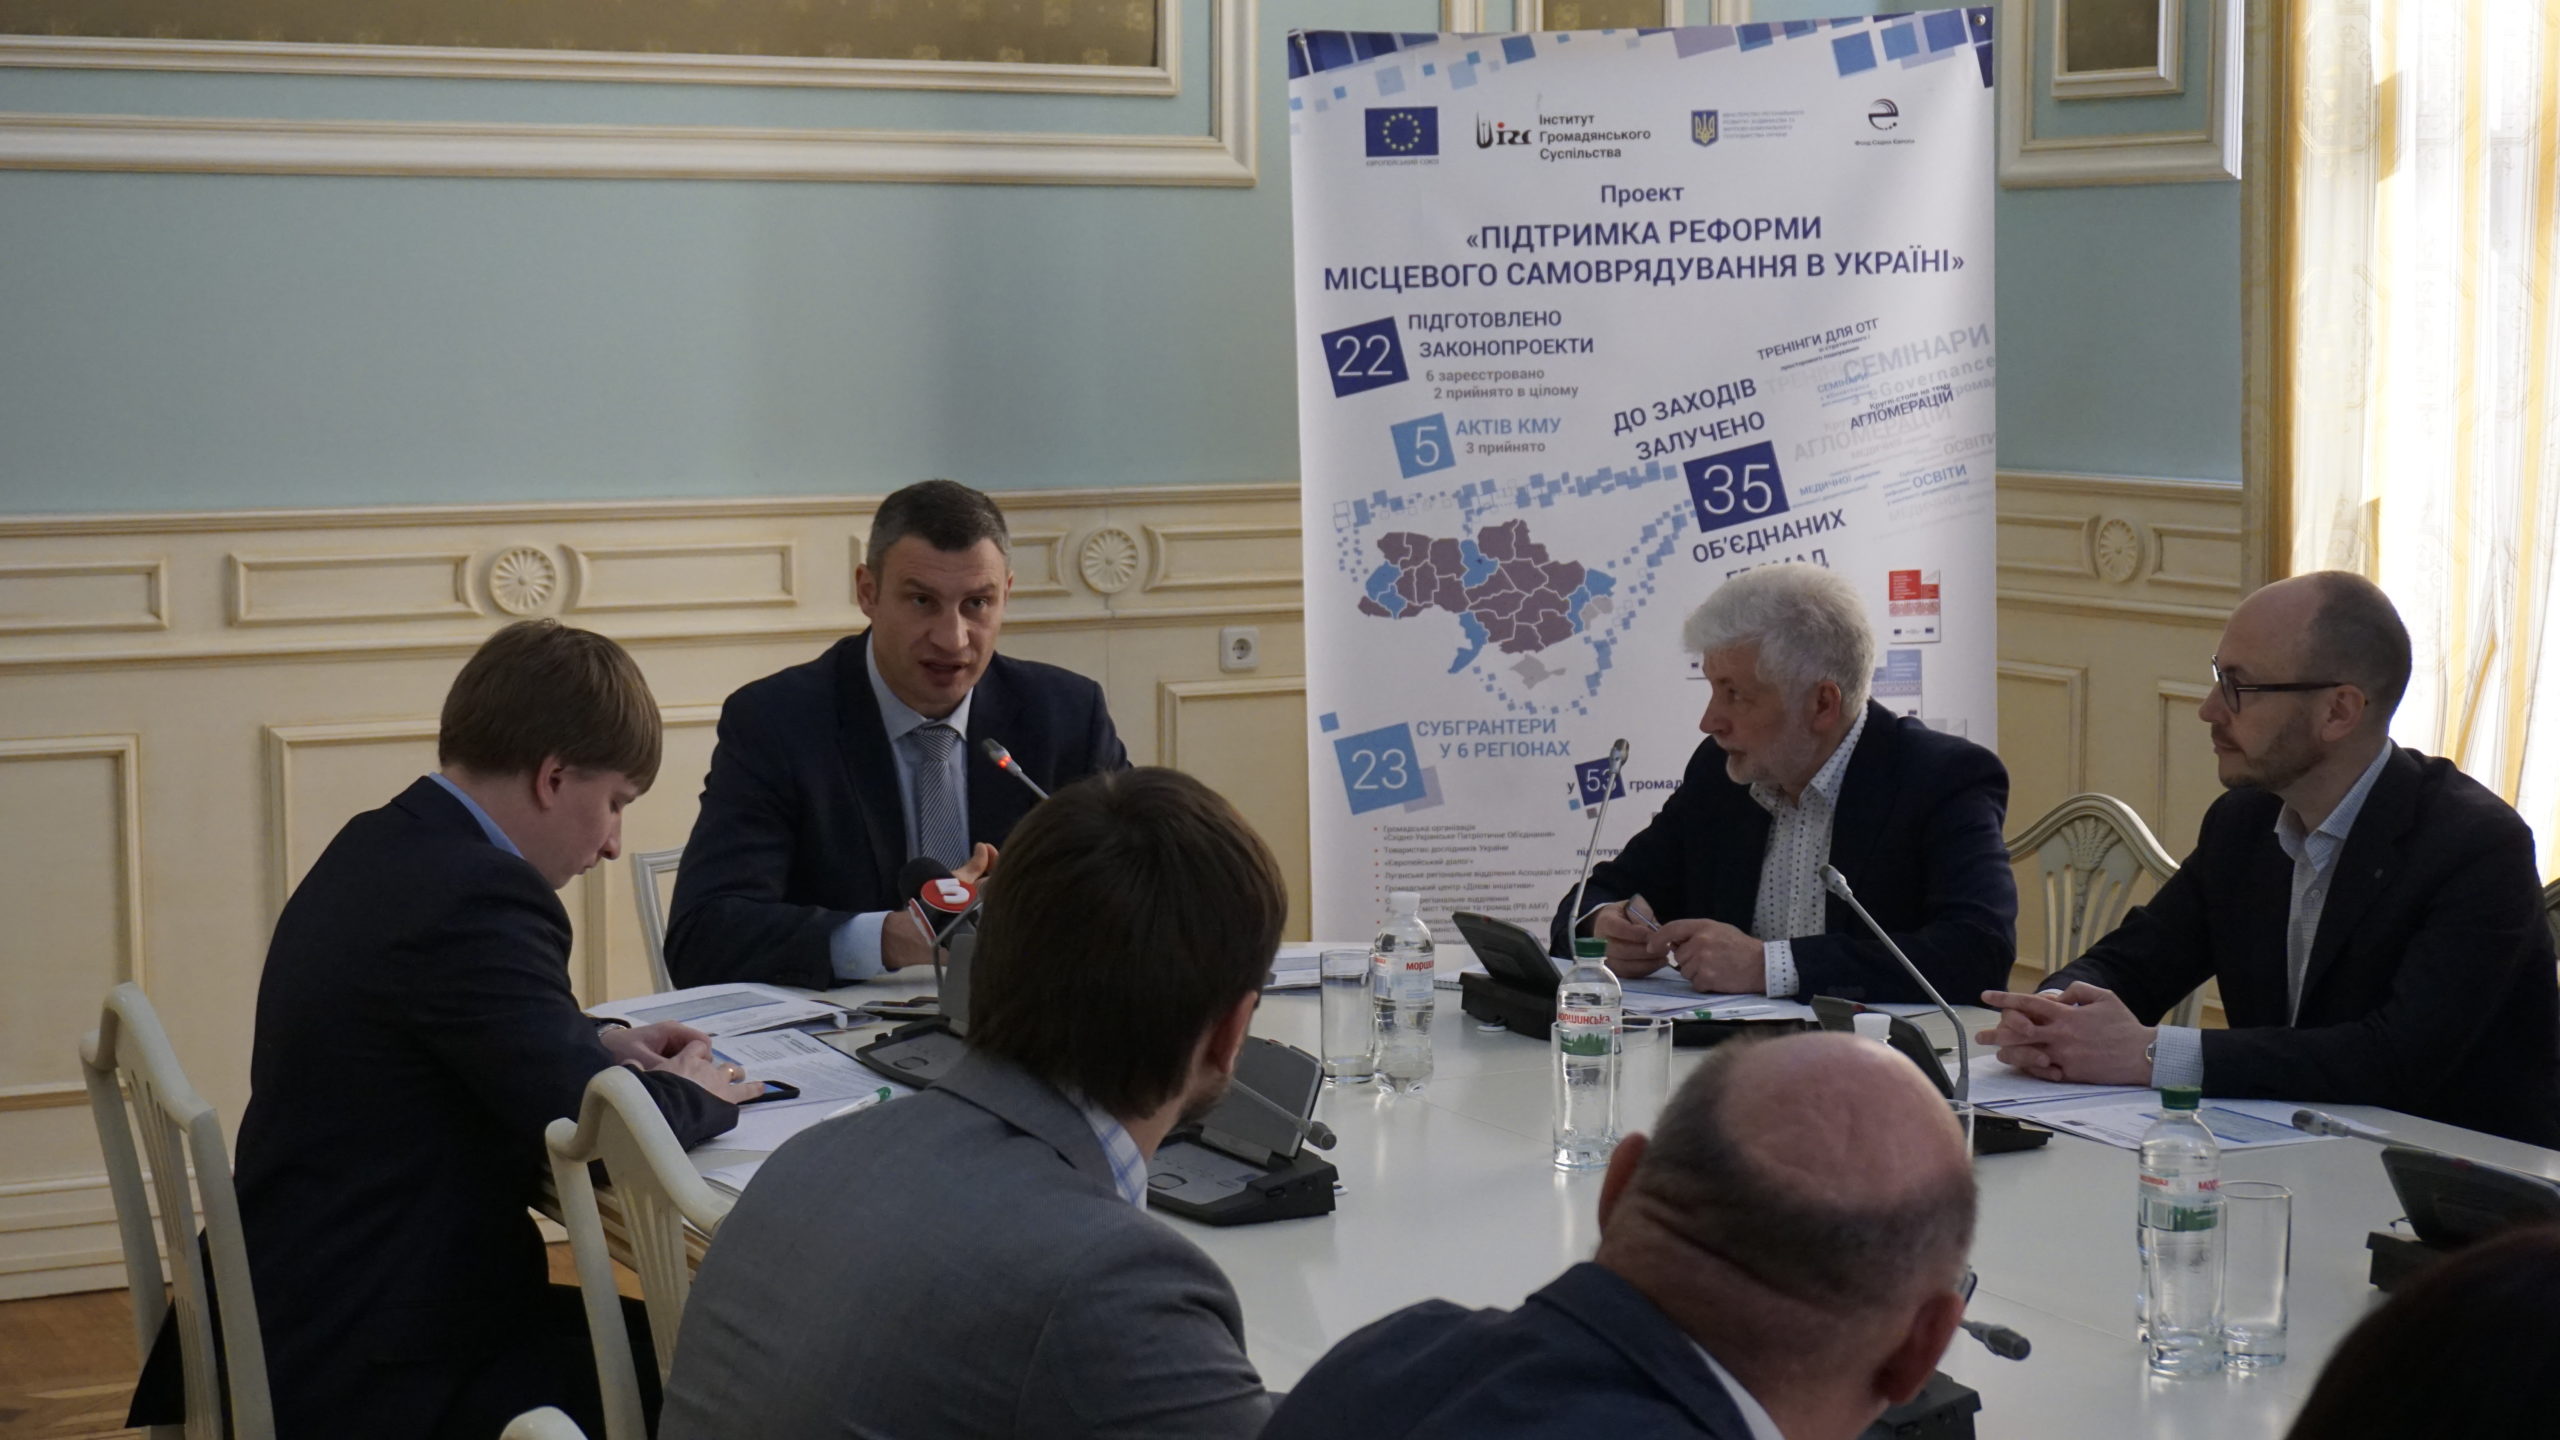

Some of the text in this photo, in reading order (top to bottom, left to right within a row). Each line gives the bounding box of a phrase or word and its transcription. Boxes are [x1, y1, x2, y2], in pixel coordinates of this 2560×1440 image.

[1539, 113, 1595, 126] Інститут
[1539, 129, 1651, 143] Громадянського
[1539, 147, 1622, 161] Суспільства
[1600, 183, 1685, 206] Проект
[1465, 215, 1822, 252] «ПІДТРИМКА РЕФОРМИ
[1323, 245, 1965, 293] МІСЦЕВОГО САМОВРЯДУВАННЯ В УКРАЇНІ»
[1408, 310, 1562, 332] ПІДГОТОВЛЕНО
[1419, 338, 1594, 358] ЗАКОНОПРОЕКТИ
[1757, 318, 1880, 361] ТРЕНІНГИ ДЛЯ ОТГ
[1843, 323, 1991, 379] СЕМІНАРИ
[1335, 334, 1393, 377] 22
[1426, 368, 1545, 383] 6 зареєстровано
[1868, 356, 1995, 400] eGovernance
[1434, 384, 1579, 401] 2 прийнято в цілому
[1613, 378, 1757, 436] ДО ЗАХОДІВ
[1850, 389, 1954, 430] АГЛОМЕРАЦІЙ
[1455, 417, 1562, 436] АКТІВ КМУ
[1636, 410, 1766, 461] ЗАЛУЧЕНО
[1415, 425, 1440, 467] 5
[1465, 440, 1546, 456] 3 прийнято
[1912, 463, 1967, 488] ОСВІТИ
[1703, 463, 1772, 515] 35
[1416, 718, 1557, 738] СУБГРАНТЕРИ
[1439, 740, 1571, 758] У 6 РЕГІОНАХ
[1352, 748, 1408, 791] 23
[1567, 782, 1575, 795] у
[935, 878, 970, 904] 5
